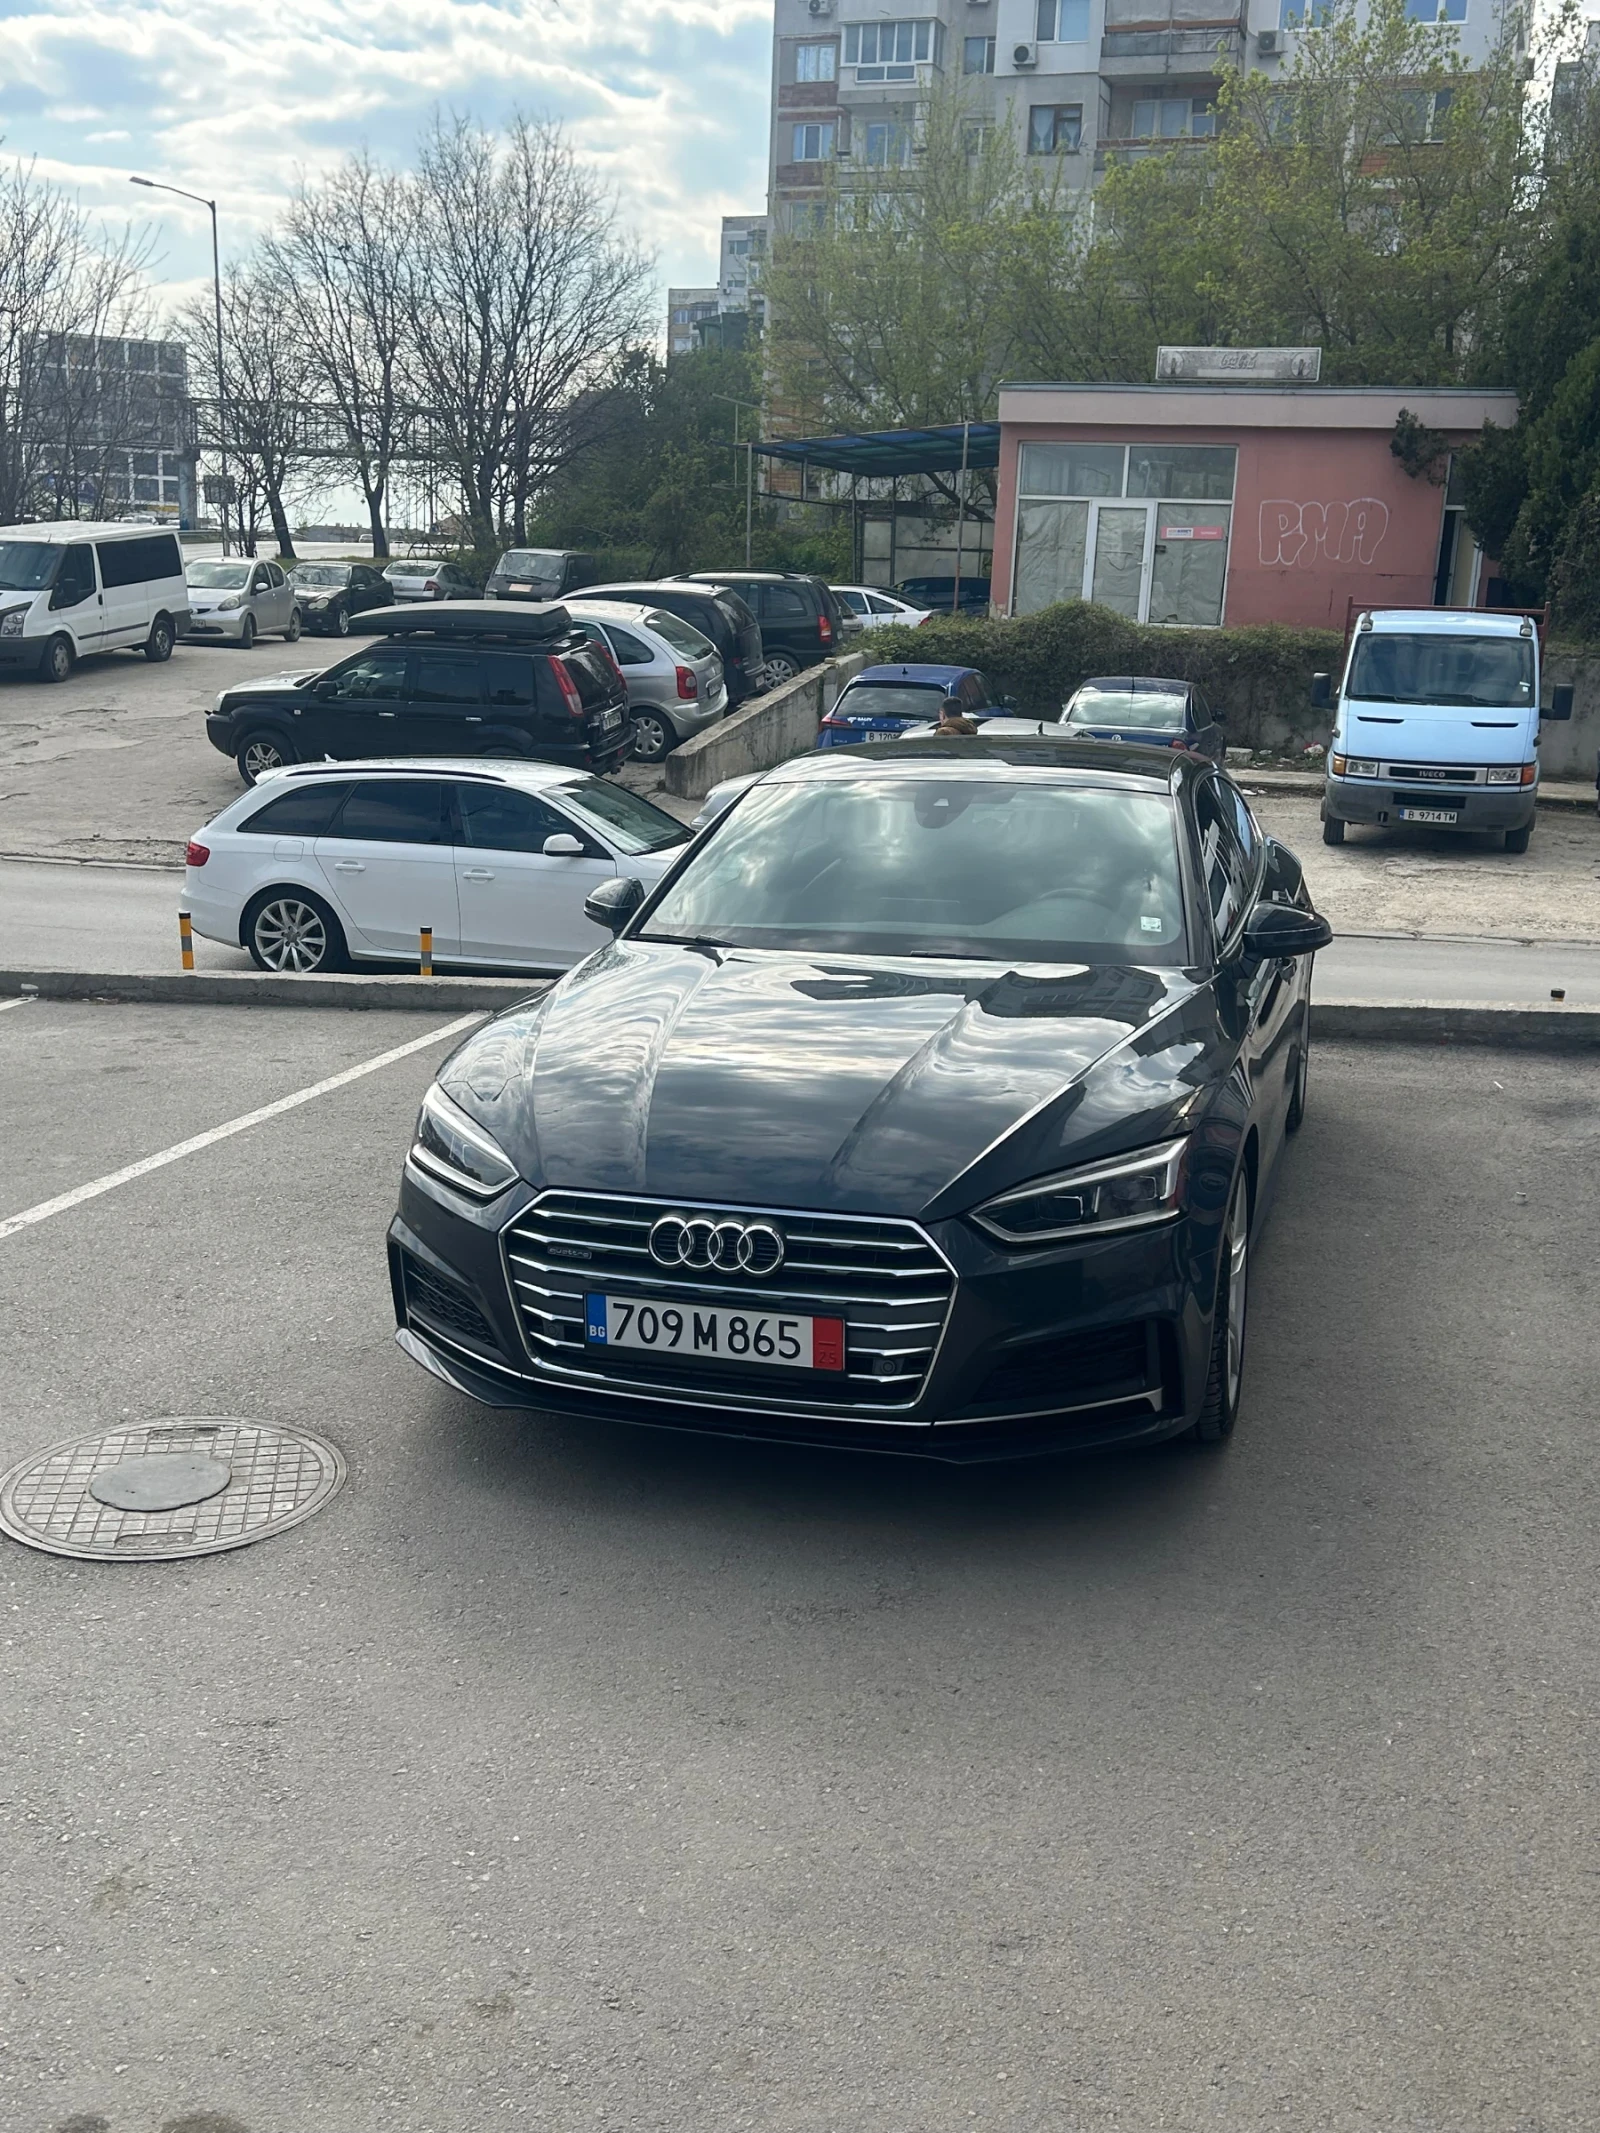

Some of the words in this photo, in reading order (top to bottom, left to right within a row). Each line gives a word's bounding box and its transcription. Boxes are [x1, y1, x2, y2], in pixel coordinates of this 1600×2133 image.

[1419, 770, 1446, 778] IVECO
[1420, 812, 1442, 821] 9714
[589, 1325, 606, 1338] BG
